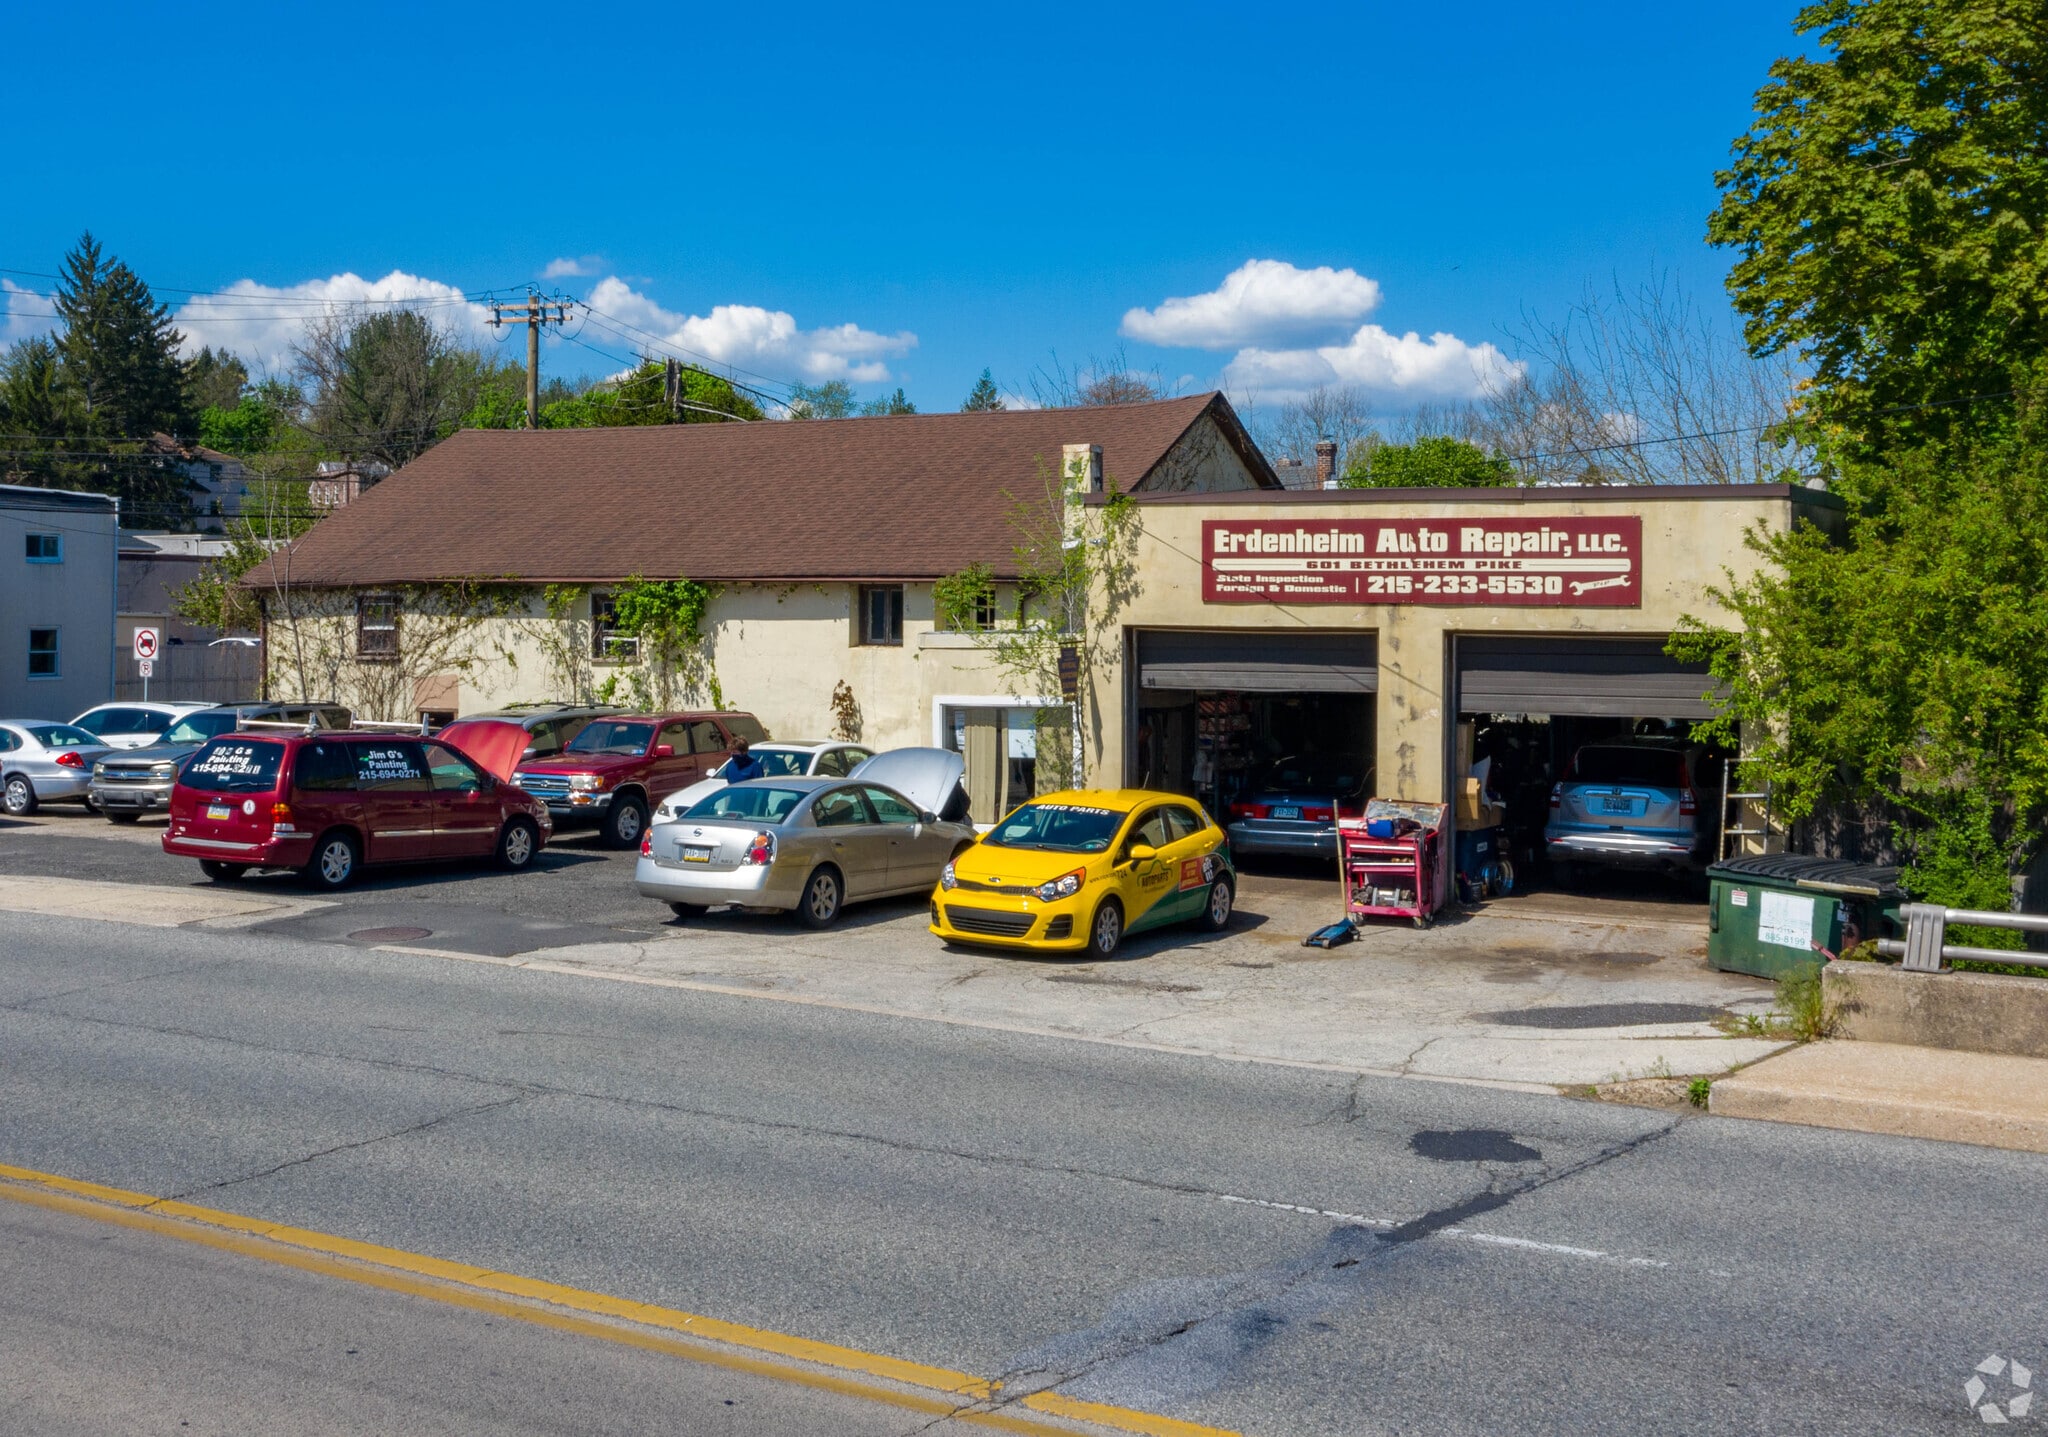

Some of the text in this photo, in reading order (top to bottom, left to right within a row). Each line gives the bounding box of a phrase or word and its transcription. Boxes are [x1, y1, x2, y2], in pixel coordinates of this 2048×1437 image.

[1213, 527, 1628, 557] Erdenheim Auto Repair, LLC.
[1306, 560, 1523, 569] 601 BETHLEHEM PIKE
[1215, 574, 1324, 584] State Inspection
[1215, 584, 1347, 593] Foreign & Domestic
[1367, 575, 1563, 595] 215-233-5530
[368, 750, 403, 759] Jim G's
[368, 760, 408, 770] Painting
[359, 769, 421, 780] 215-694-0271
[1069, 805, 1111, 816] PARTS
